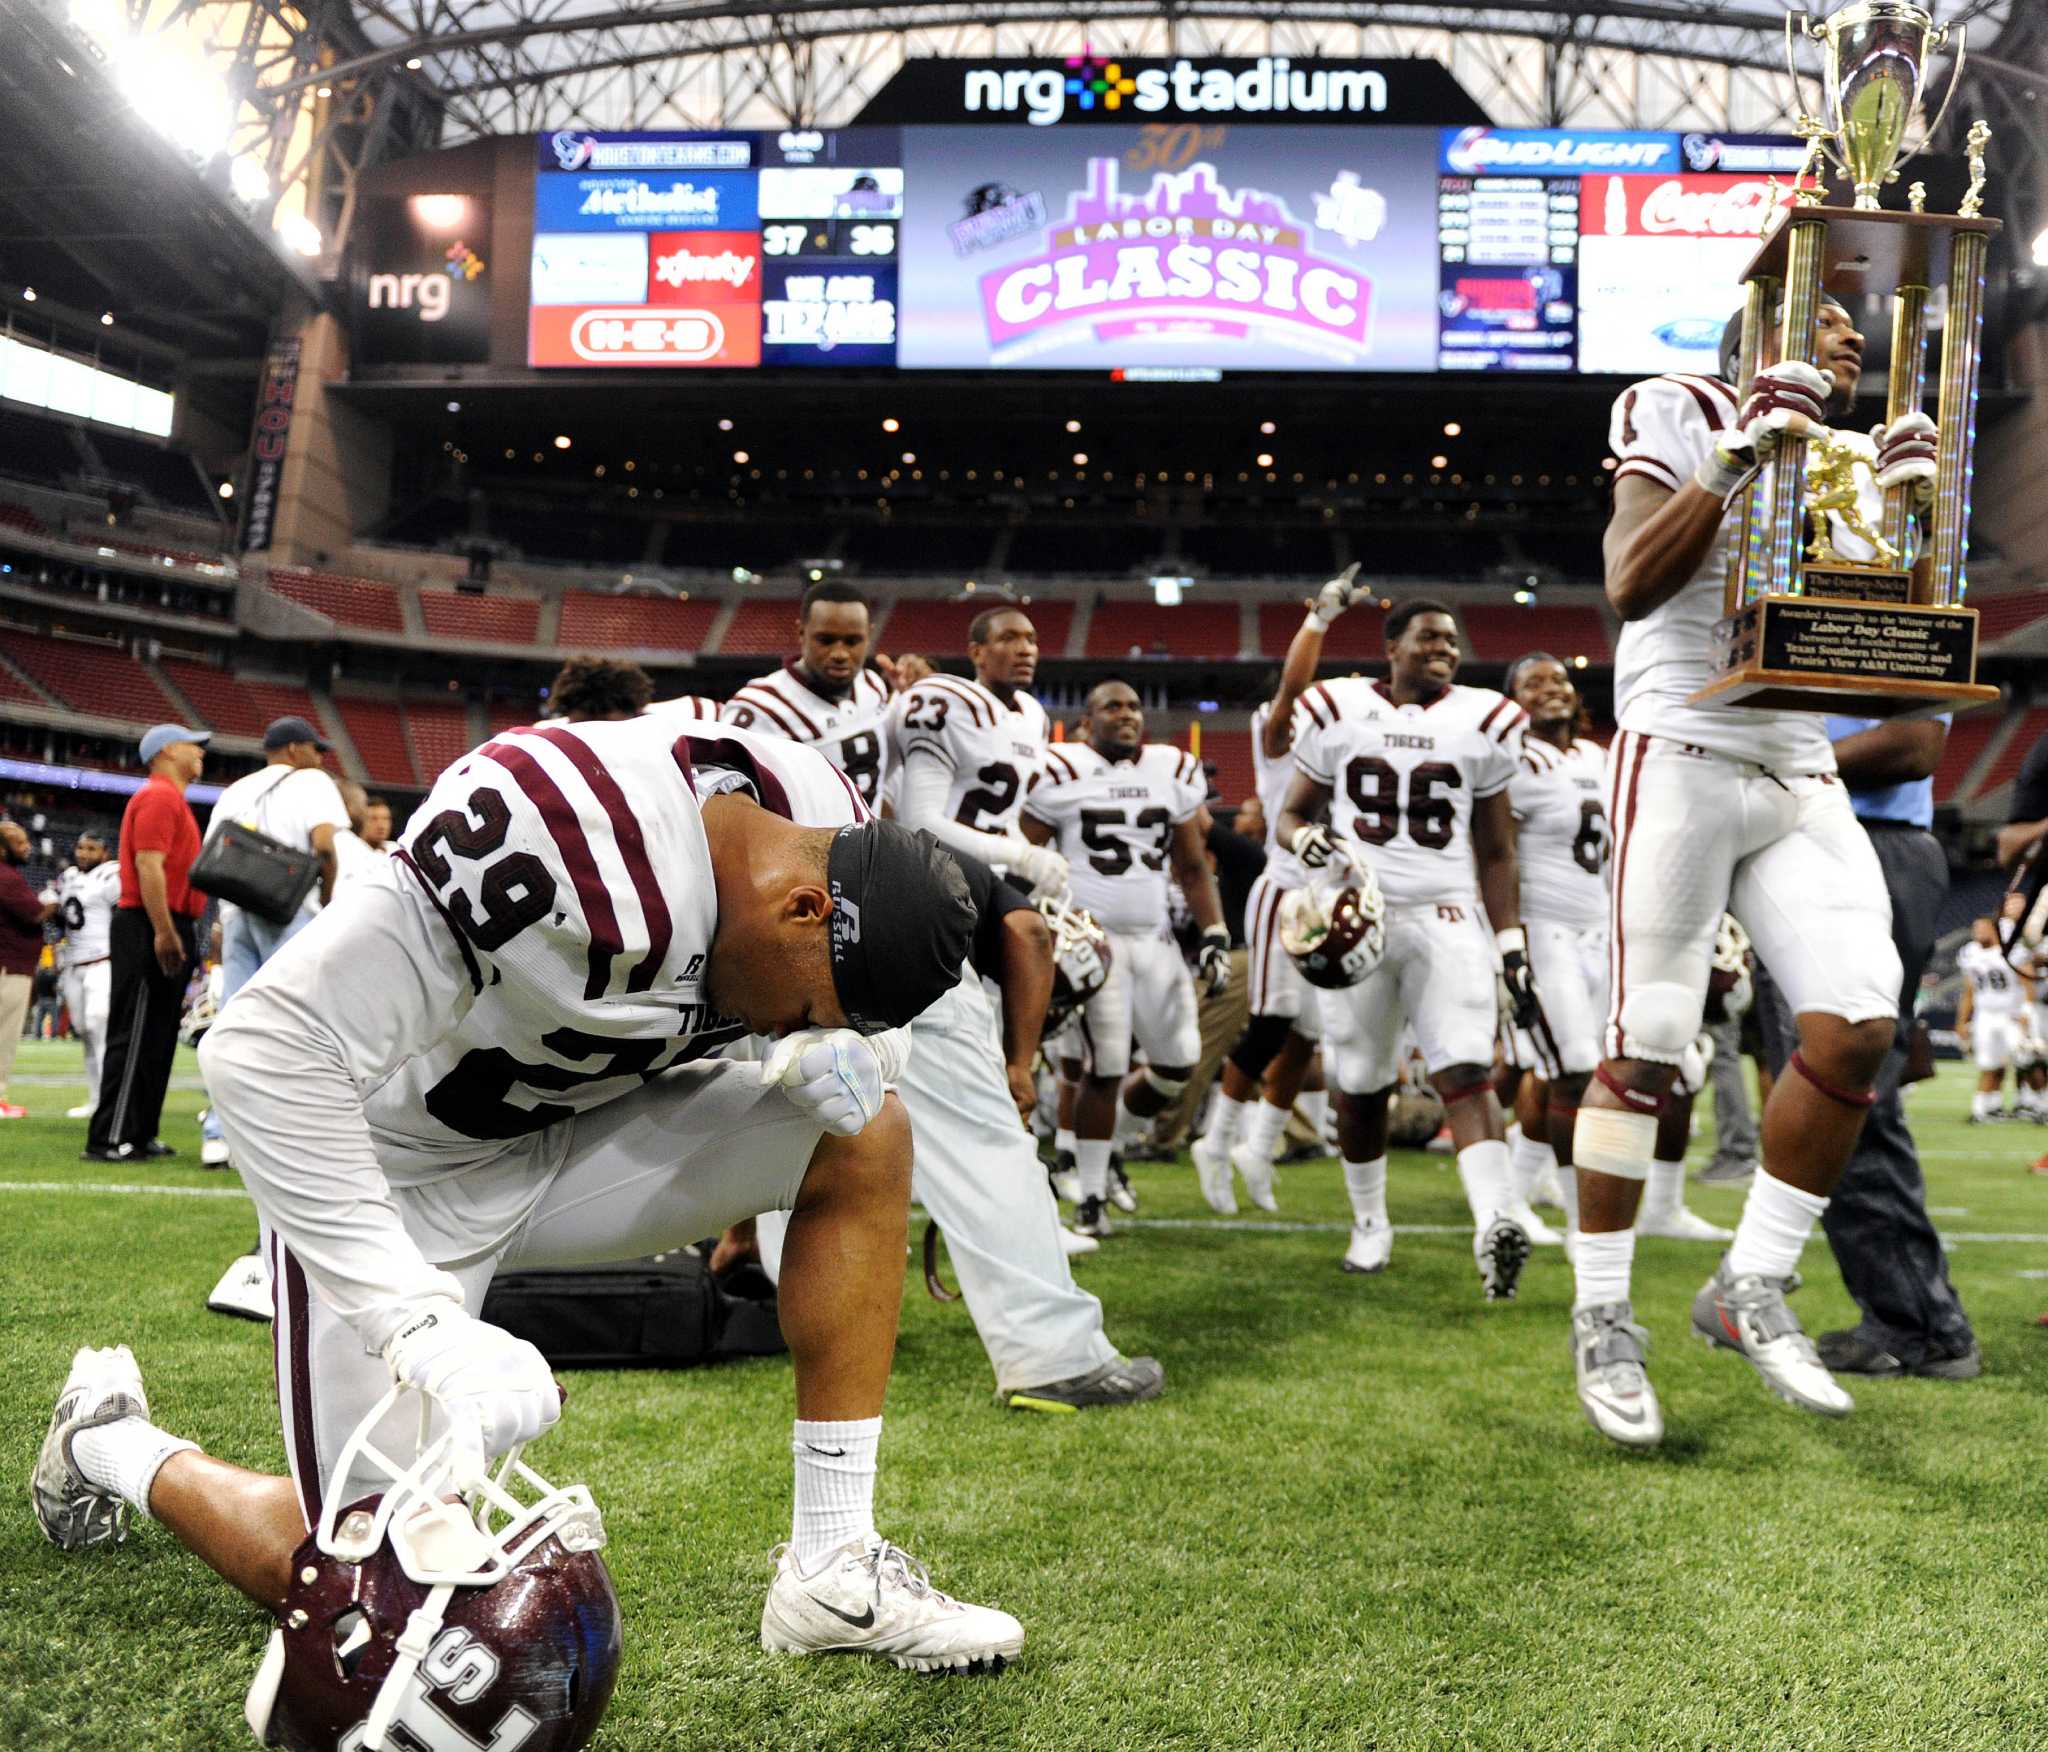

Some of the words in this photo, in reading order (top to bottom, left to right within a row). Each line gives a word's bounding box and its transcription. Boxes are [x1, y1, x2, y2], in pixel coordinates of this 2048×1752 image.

[965, 69, 1065, 125] nrg
[1134, 58, 1387, 111] stadium
[762, 225, 808, 255] 37
[1074, 217, 1195, 244] LABOR
[1211, 217, 1281, 246] DAY
[655, 249, 755, 288] xfinity
[995, 244, 1360, 327] CLASSIC
[368, 273, 451, 322] nrg
[1621, 389, 1638, 447] 1
[1811, 621, 1851, 634] Labor
[1853, 625, 1880, 638] Day
[1882, 626, 1930, 640] Classic
[1824, 610, 1866, 624] Annually
[1868, 613, 1879, 624] to
[1880, 613, 1897, 625] the
[1785, 642, 1817, 654] Texas
[1818, 645, 1870, 659] Southern
[1872, 649, 1928, 664] University
[1930, 652, 1953, 665] and
[1842, 635, 1859, 647] the
[1789, 654, 1827, 668] Prairie
[1829, 656, 1857, 669] View
[1859, 659, 1888, 671] A&M
[1889, 661, 1948, 677] University
[904, 694, 949, 731] 23
[1383, 733, 1435, 750] TIGERS
[840, 727, 881, 808] 8
[1346, 755, 1462, 850] 96
[1080, 806, 1172, 876] 53
[412, 786, 557, 953] 29
[831, 879, 845, 963] RUSSELL
